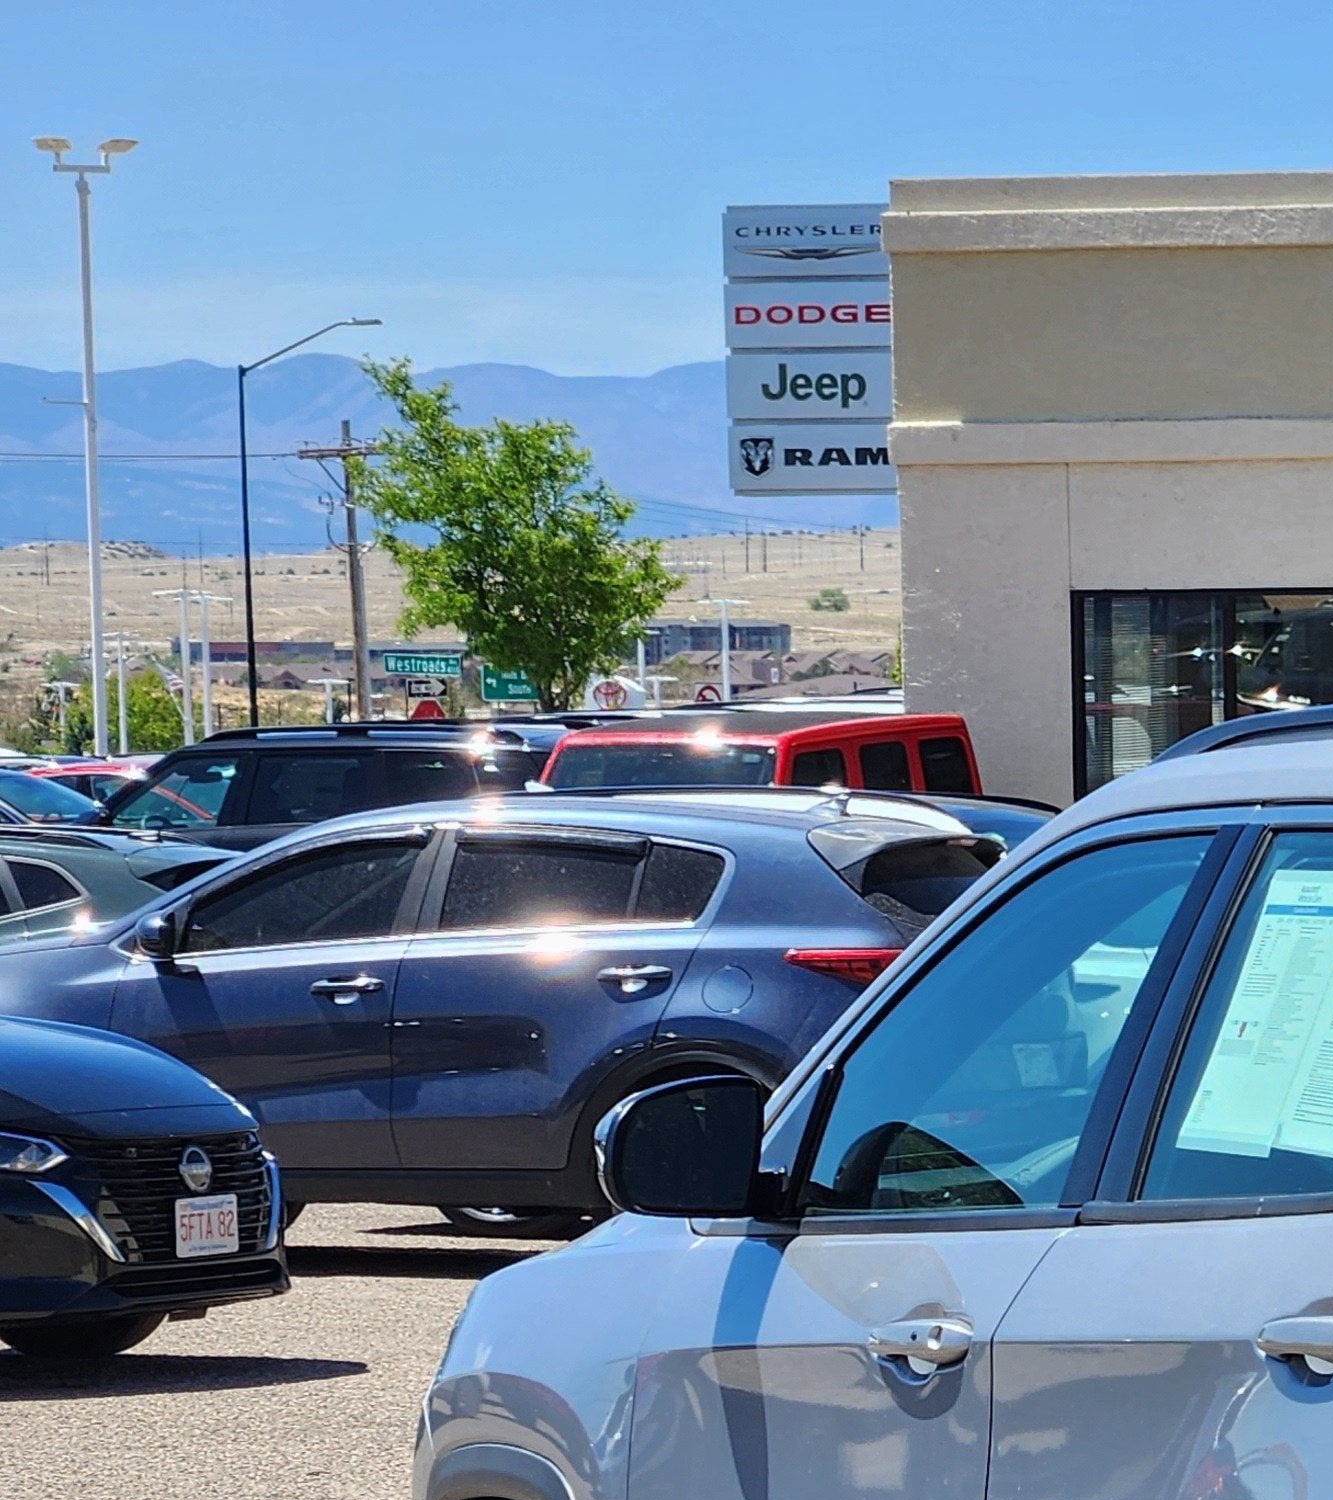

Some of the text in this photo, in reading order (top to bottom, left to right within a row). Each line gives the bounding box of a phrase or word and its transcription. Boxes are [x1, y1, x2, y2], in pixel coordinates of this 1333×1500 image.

[735, 224, 882, 238] CHRYSLER
[735, 303, 891, 325] DODGE
[761, 363, 867, 409] Jeep
[784, 447, 891, 467] RAM
[386, 656, 447, 673] Westroads
[180, 1210, 236, 1242] 5FTA 82
